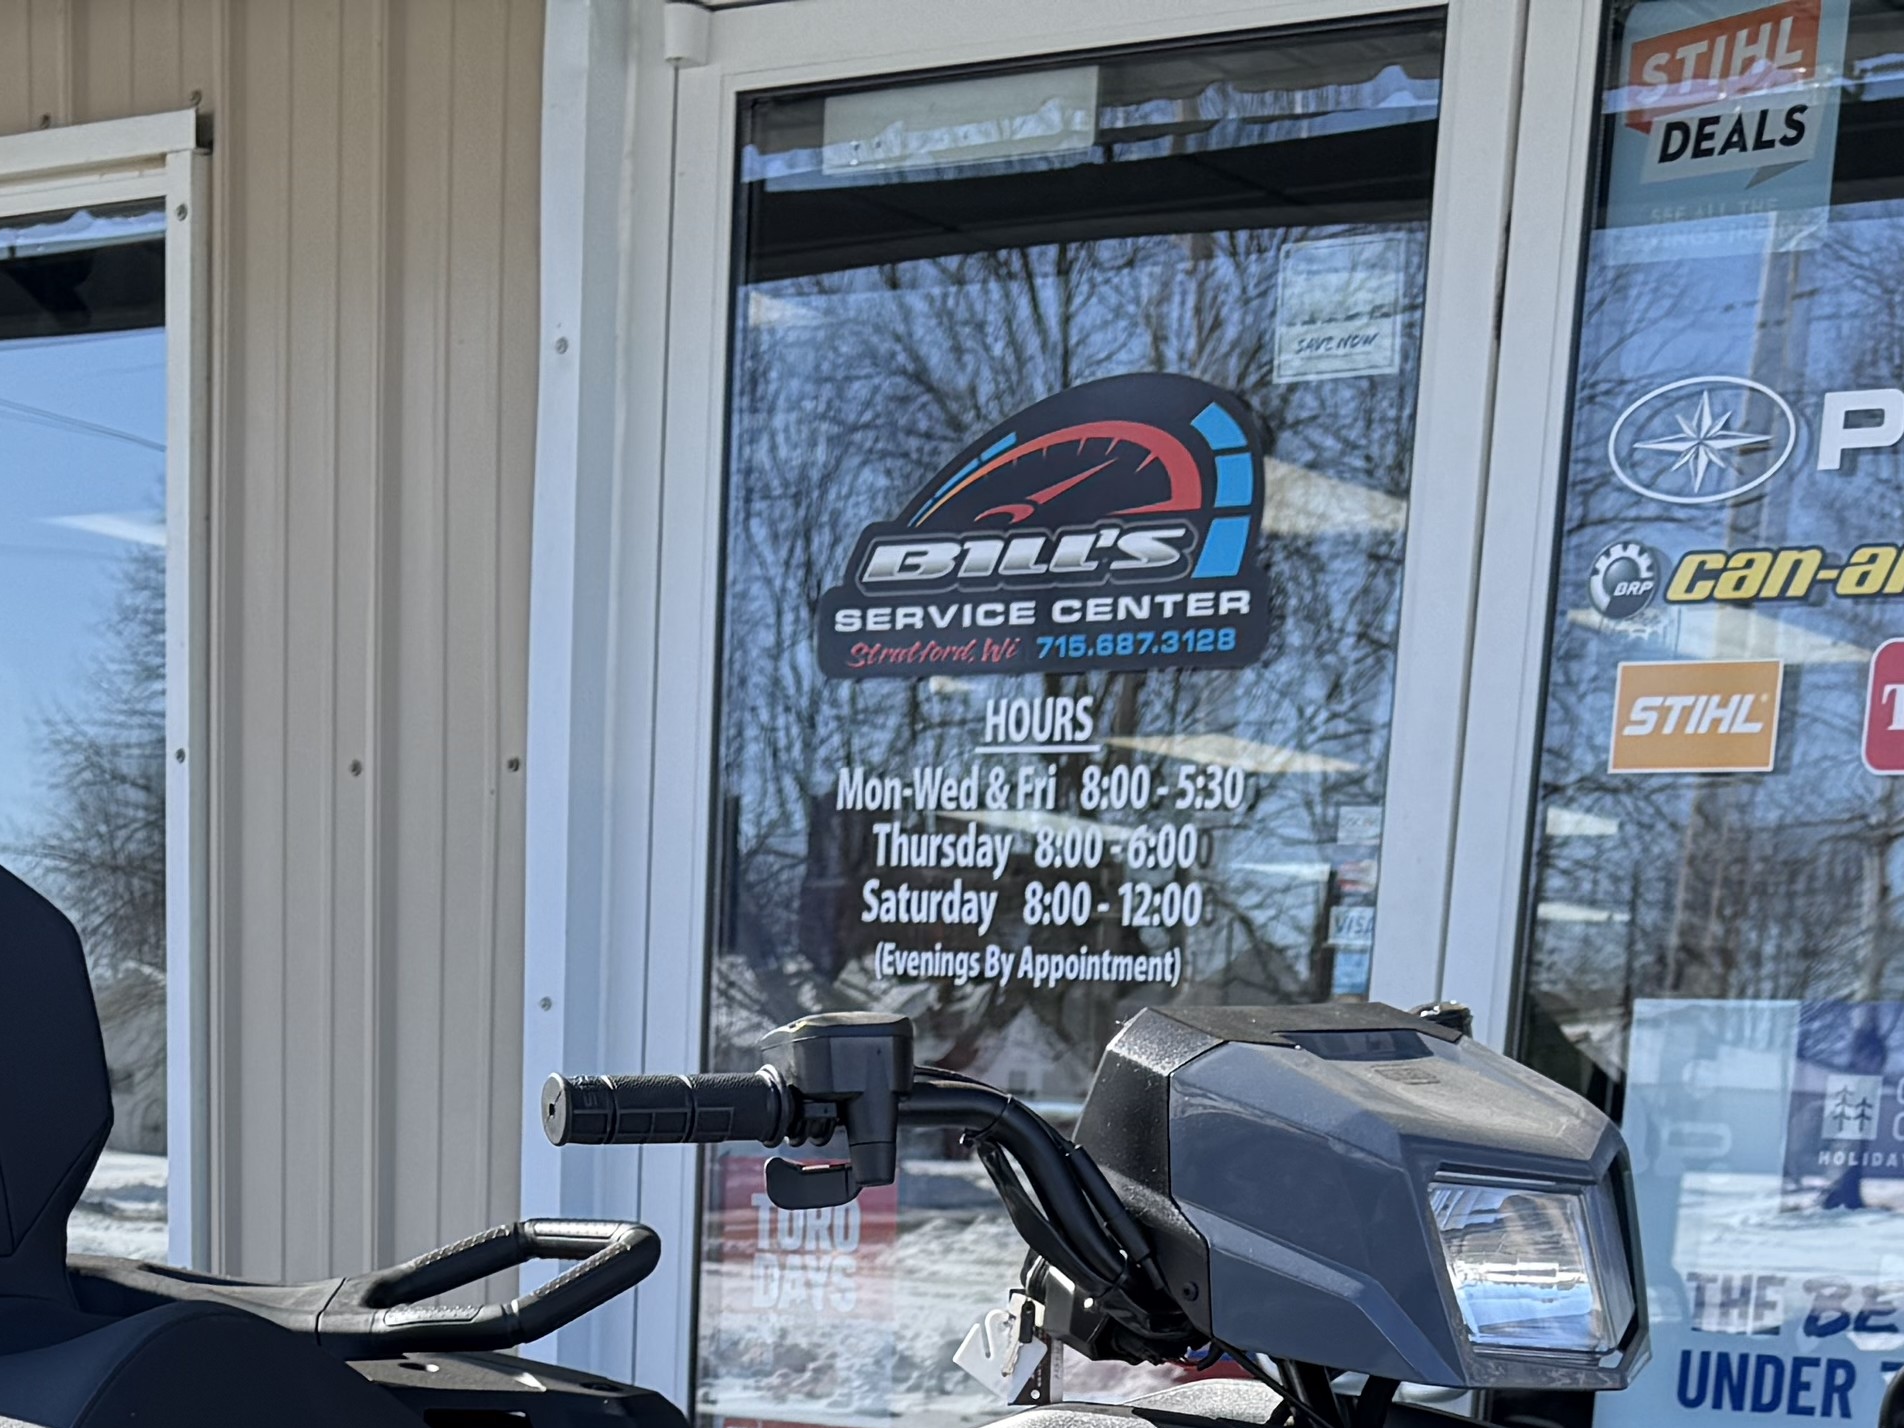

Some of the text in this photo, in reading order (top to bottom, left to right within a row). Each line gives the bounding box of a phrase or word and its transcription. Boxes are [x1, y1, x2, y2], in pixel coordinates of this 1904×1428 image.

[1642, 15, 1804, 101] STIHL
[1658, 104, 1809, 164] DEALS
[861, 527, 1187, 583] BILL'S
[834, 590, 1251, 633] SERVICE CENTER
[1614, 577, 1654, 598] BRP
[1036, 627, 1237, 660] 715.687.3128
[984, 696, 1094, 743] HOURS
[1622, 694, 1760, 736] STIHL
[836, 765, 979, 811] Mon-Wed
[986, 766, 1009, 811] &
[1017, 764, 1057, 811] Fri
[1080, 764, 1150, 810] 8:00
[1176, 764, 1244, 810] 5:30
[873, 821, 1012, 879] Thursday
[1035, 824, 1103, 868] 8:00
[1128, 823, 1196, 869] 6:00
[861, 878, 998, 937] Saturday
[1023, 880, 1091, 927] 8:00
[1119, 881, 1202, 927] 12:00
[874, 941, 1182, 987] (Evenings By Appointment)
[751, 1192, 862, 1252] TORO
[752, 1252, 858, 1313] DAYS
[1686, 1271, 1786, 1336] THE
[1677, 1348, 1857, 1419] UNDER
